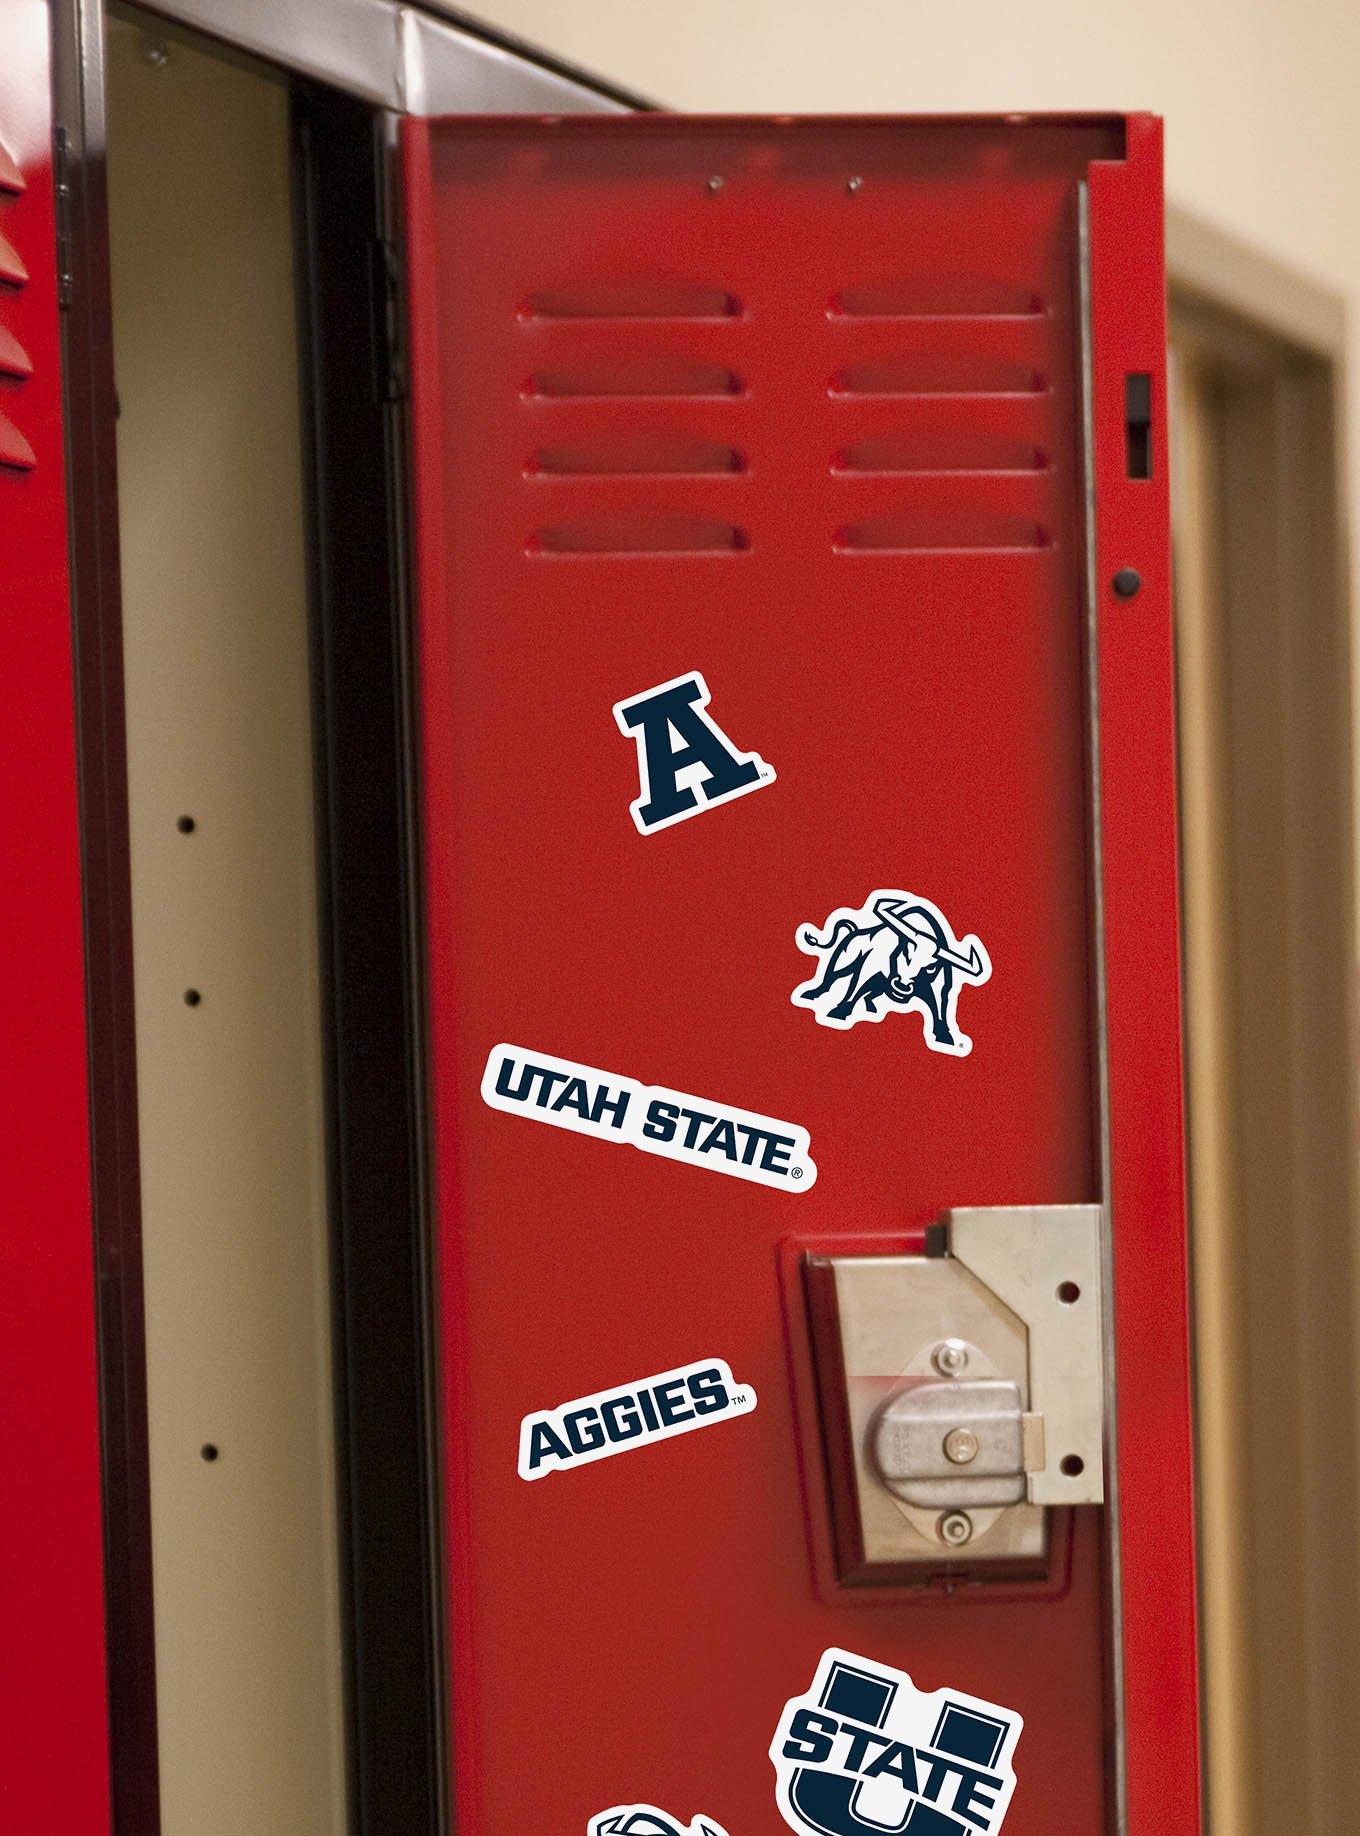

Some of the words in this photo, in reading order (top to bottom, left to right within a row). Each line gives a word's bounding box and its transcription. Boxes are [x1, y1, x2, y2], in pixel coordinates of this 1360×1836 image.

[622, 680, 761, 827] A
[495, 1058, 631, 1129] UTAH
[529, 1368, 730, 1470] AGGIES
[782, 1709, 1004, 1832] STATE
